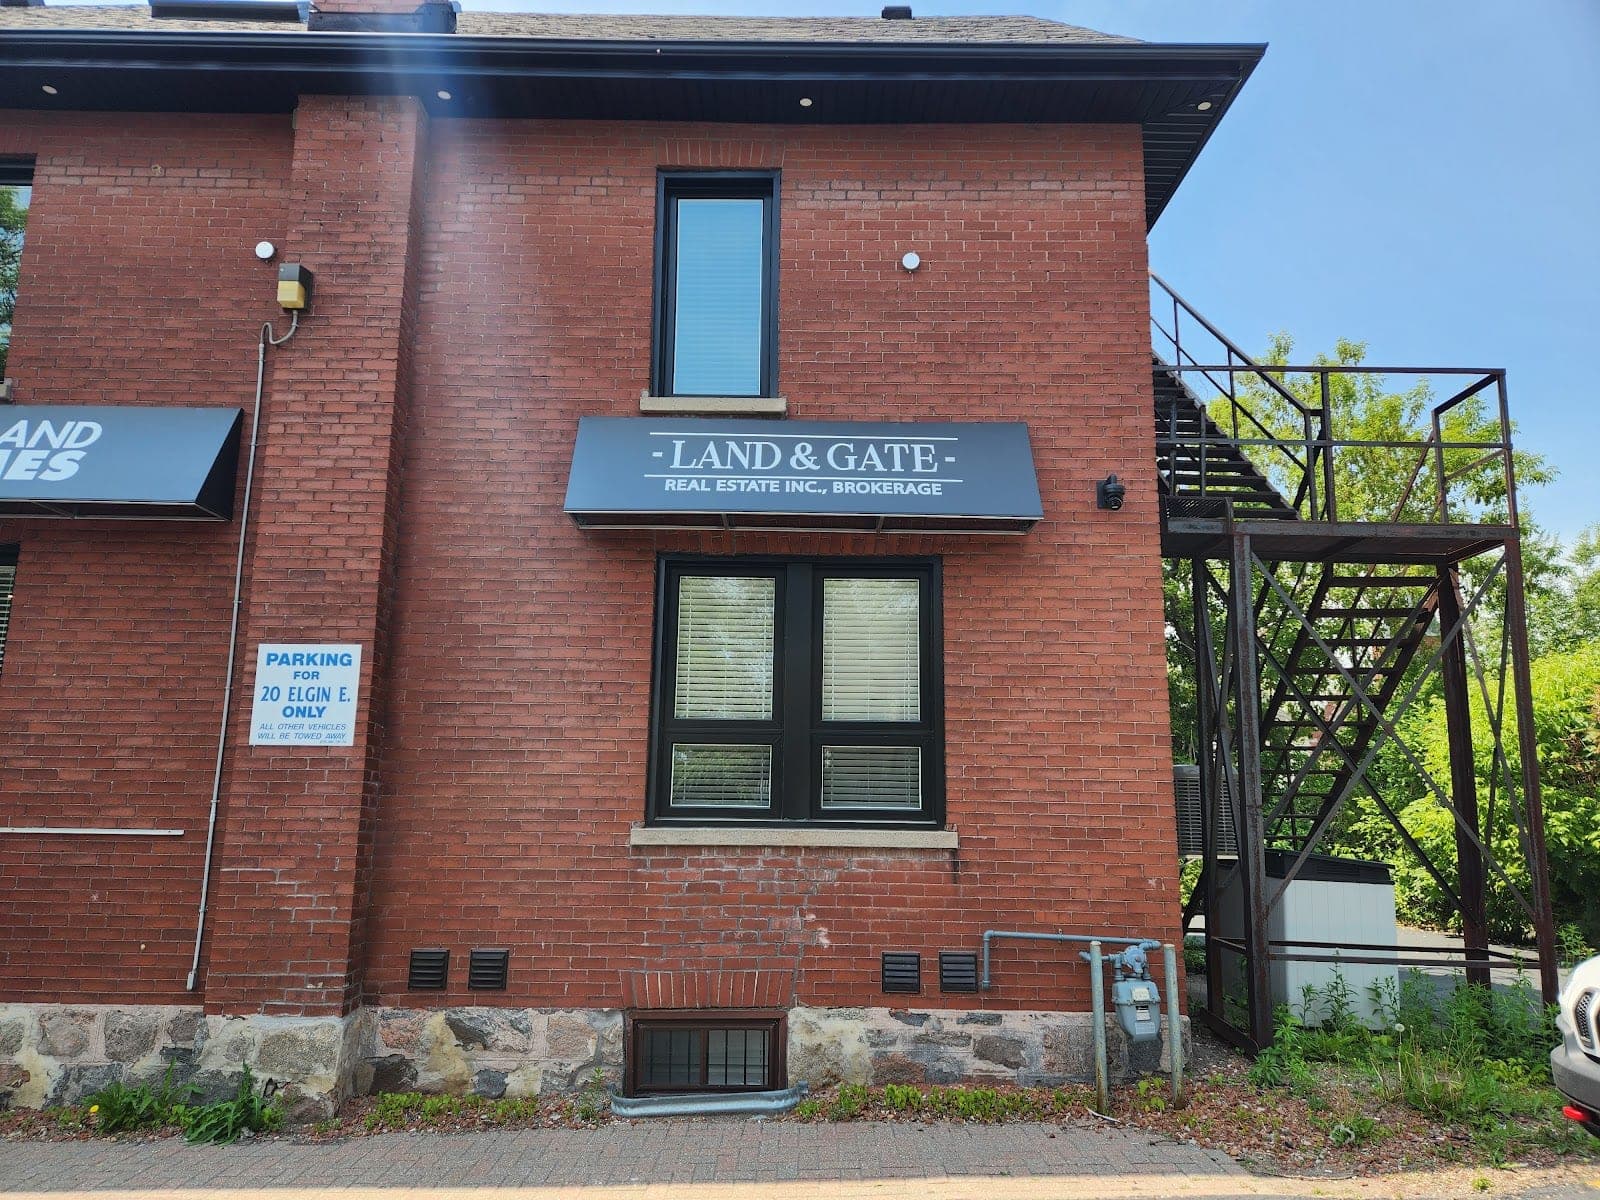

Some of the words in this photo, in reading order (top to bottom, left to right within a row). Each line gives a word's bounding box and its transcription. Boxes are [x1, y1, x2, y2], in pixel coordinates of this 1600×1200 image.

[669, 439, 782, 470] LAND
[789, 442, 820, 470] &
[826, 442, 938, 473] GATE
[0, 450, 87, 481] ES
[664, 478, 711, 492] REAL
[716, 479, 780, 493] ESTATE
[832, 481, 943, 496] BROKERAGE
[266, 653, 353, 667] PARKING
[293, 671, 320, 680] FOR
[260, 686, 281, 702] 20
[288, 686, 332, 703] ELGIN
[338, 687, 351, 703] E.
[282, 706, 327, 718] ONLY
[308, 723, 347, 731] VEHICLES
[257, 732, 276, 740] WILL
[279, 732, 291, 740] BE
[294, 732, 322, 740] TOWED
[325, 732, 347, 740] AWAY
